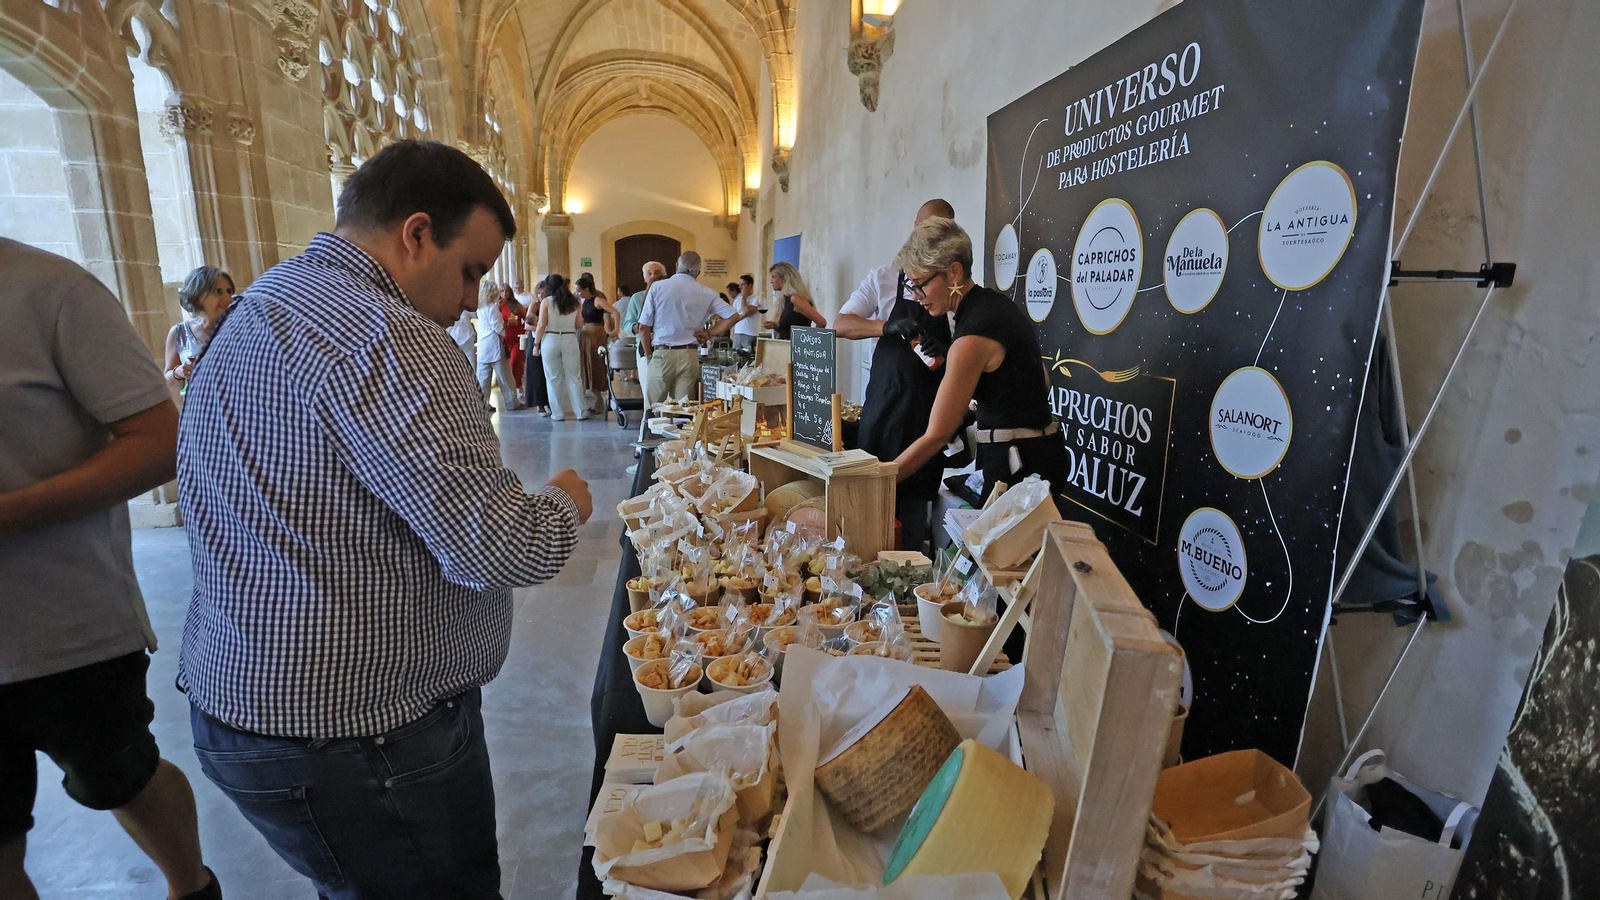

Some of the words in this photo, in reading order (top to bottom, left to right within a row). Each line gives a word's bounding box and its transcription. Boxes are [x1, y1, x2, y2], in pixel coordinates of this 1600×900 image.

[1064, 42, 1200, 136] UNIVERSO
[1047, 148, 1061, 169] DE
[1062, 120, 1132, 164] PRODUCTOS
[1136, 84, 1225, 136] GOURMET
[1058, 164, 1088, 190] PARA
[1091, 129, 1190, 181] HOSTELERÍA
[1267, 221, 1281, 232] LA
[1287, 214, 1348, 230] ANTIGUA
[1078, 248, 1136, 265] CAPRICHOS
[1167, 252, 1222, 277] Manuela
[1183, 247, 1194, 258] De
[1195, 246, 1203, 257] la
[1076, 271, 1088, 283] del
[1090, 269, 1134, 283] PALADAR
[1033, 287, 1052, 299] pastora
[1047, 385, 1153, 443] APRICHOS
[1218, 409, 1282, 434] SALANORT
[1076, 428, 1135, 466] SABOR
[1181, 540, 1242, 580] M.BUENO
